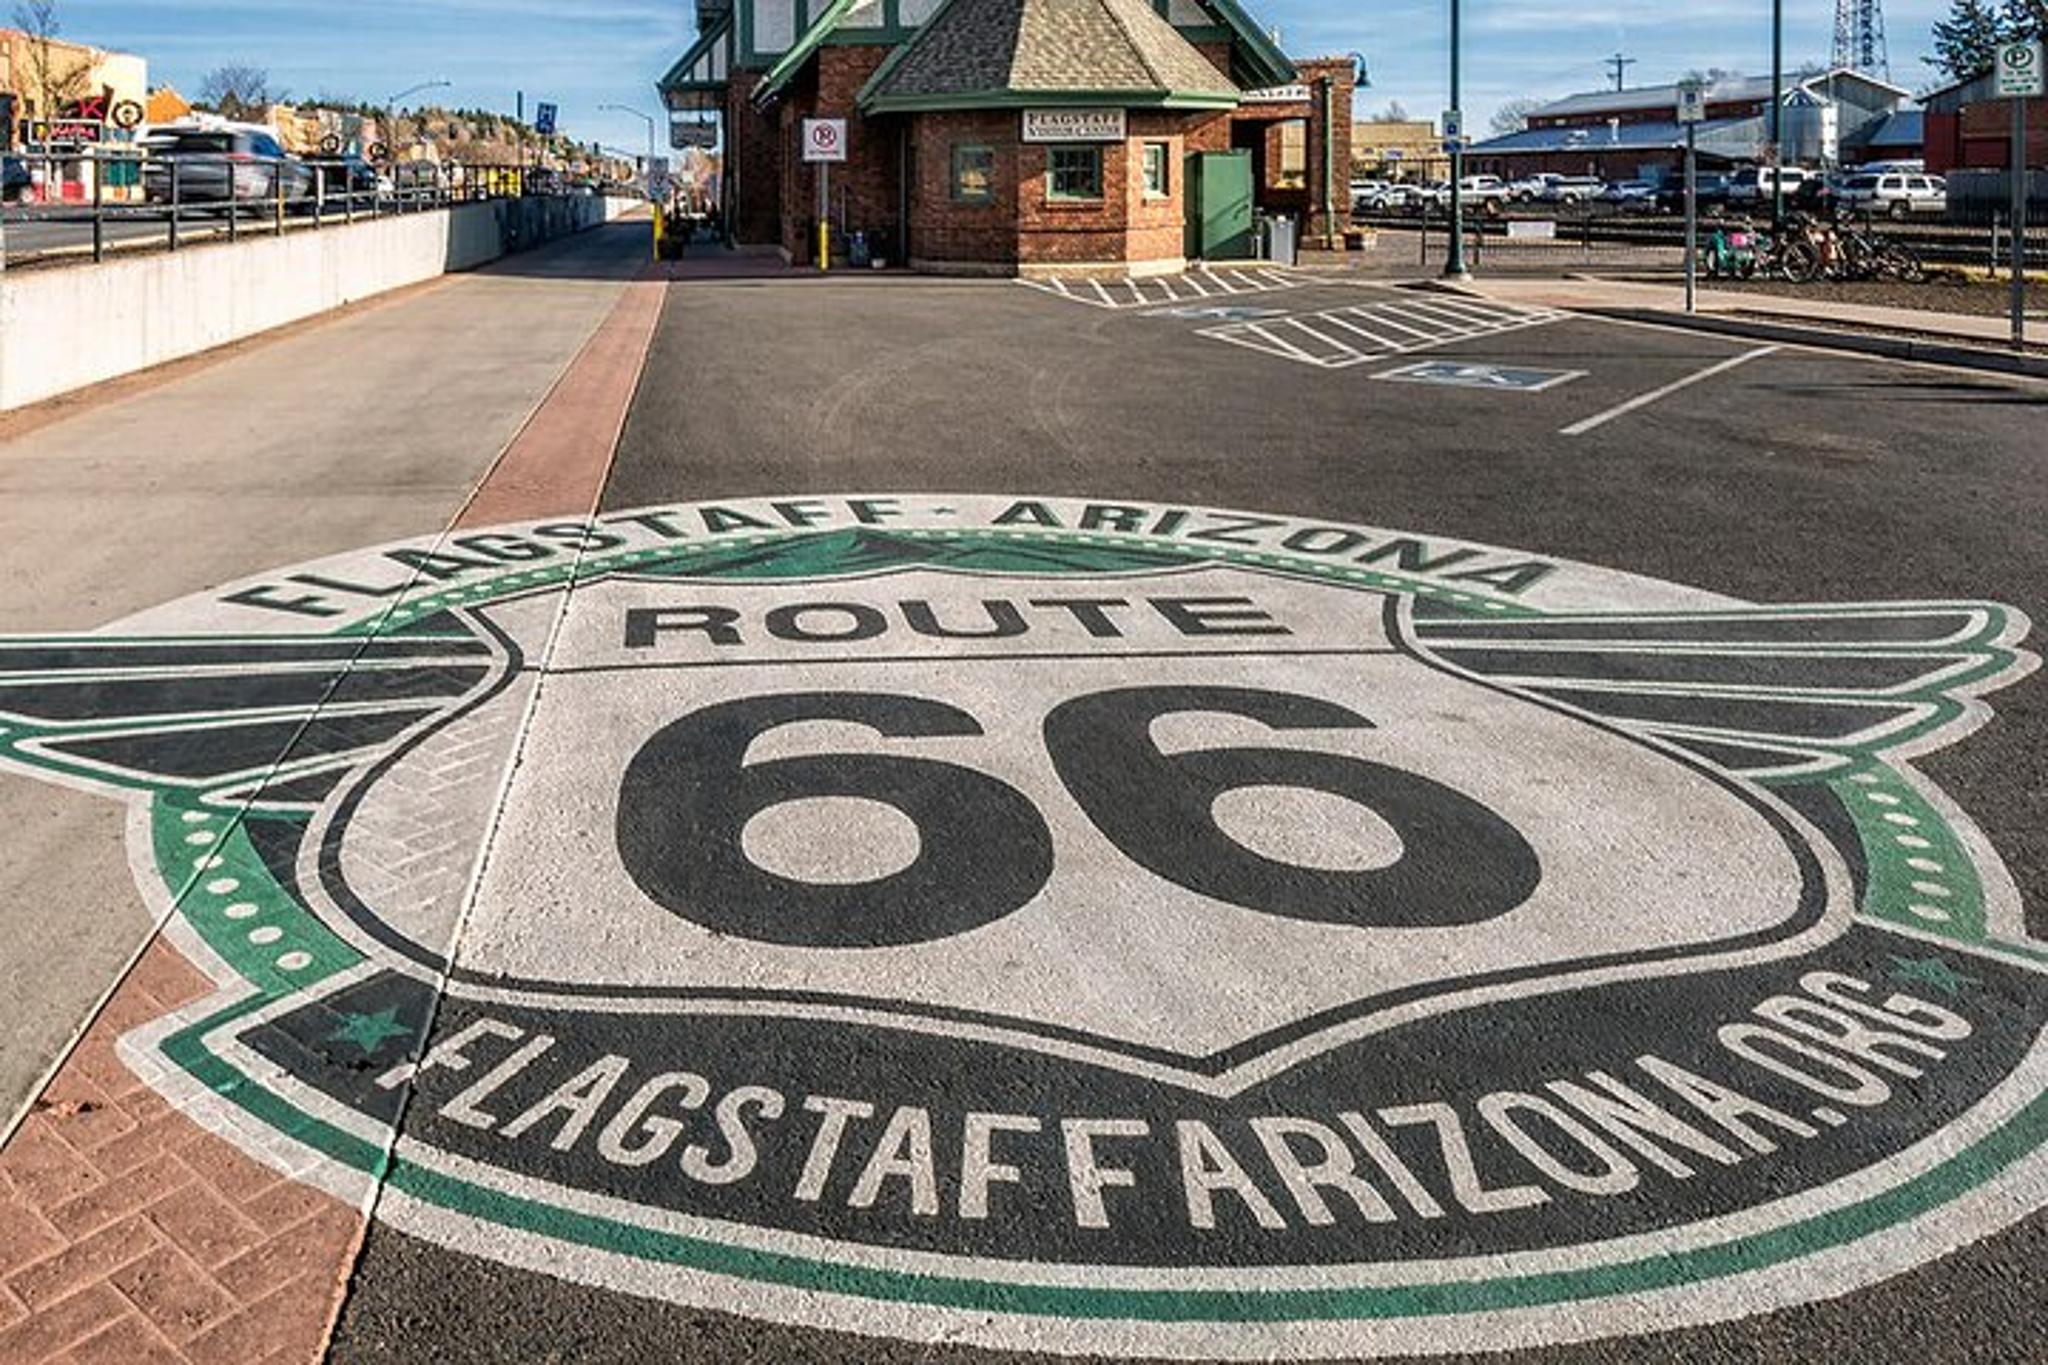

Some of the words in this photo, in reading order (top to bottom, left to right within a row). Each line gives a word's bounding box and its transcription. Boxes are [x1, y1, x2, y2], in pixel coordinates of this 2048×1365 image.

[1028, 112, 1121, 125] FLAGSTAFF
[219, 499, 904, 617] FLAGSTAFF
[992, 500, 1560, 593] ARIZONA
[622, 597, 1293, 650] ROUTE
[615, 685, 1543, 949] 66
[374, 970, 1975, 1231] FLAGSTAFFARIZONA.ORG
